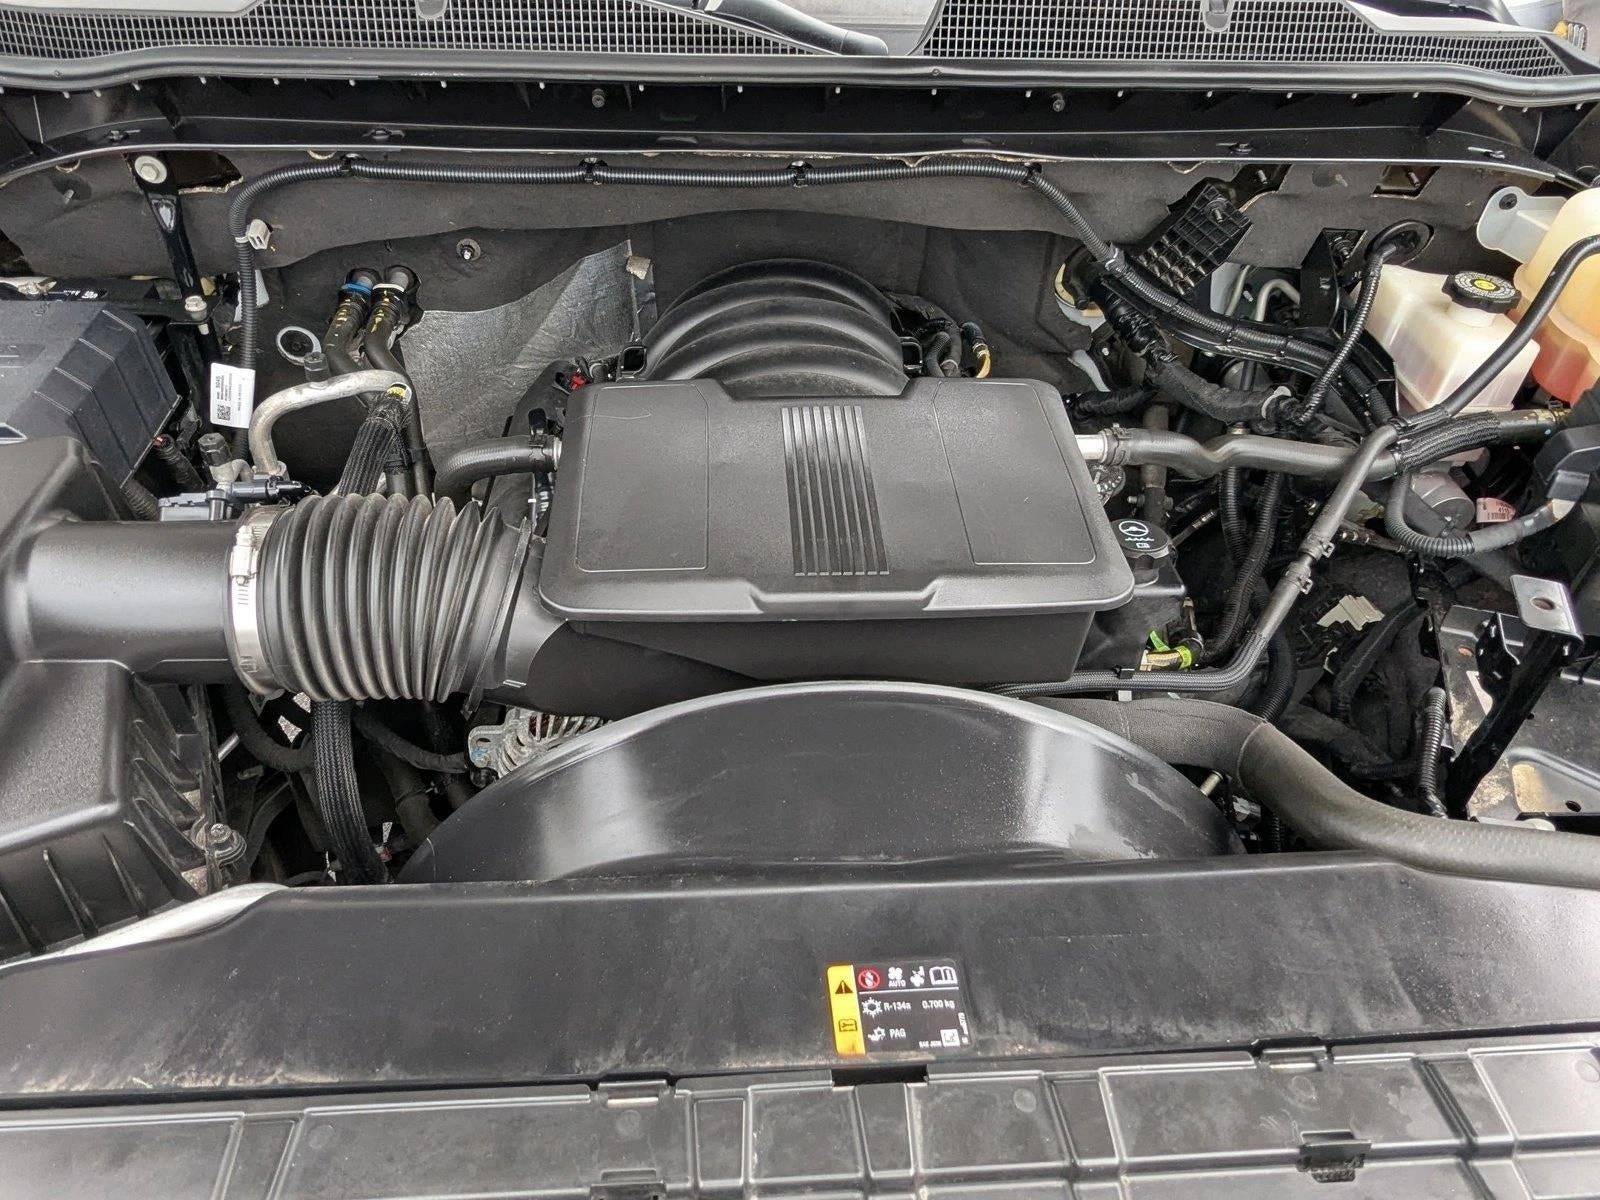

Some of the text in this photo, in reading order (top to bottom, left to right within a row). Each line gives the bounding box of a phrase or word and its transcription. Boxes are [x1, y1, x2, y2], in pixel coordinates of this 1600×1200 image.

[889, 979, 906, 988] AUTO
[884, 999, 955, 1011] R-134a 0.700 kg
[889, 1028, 906, 1038] PAG
